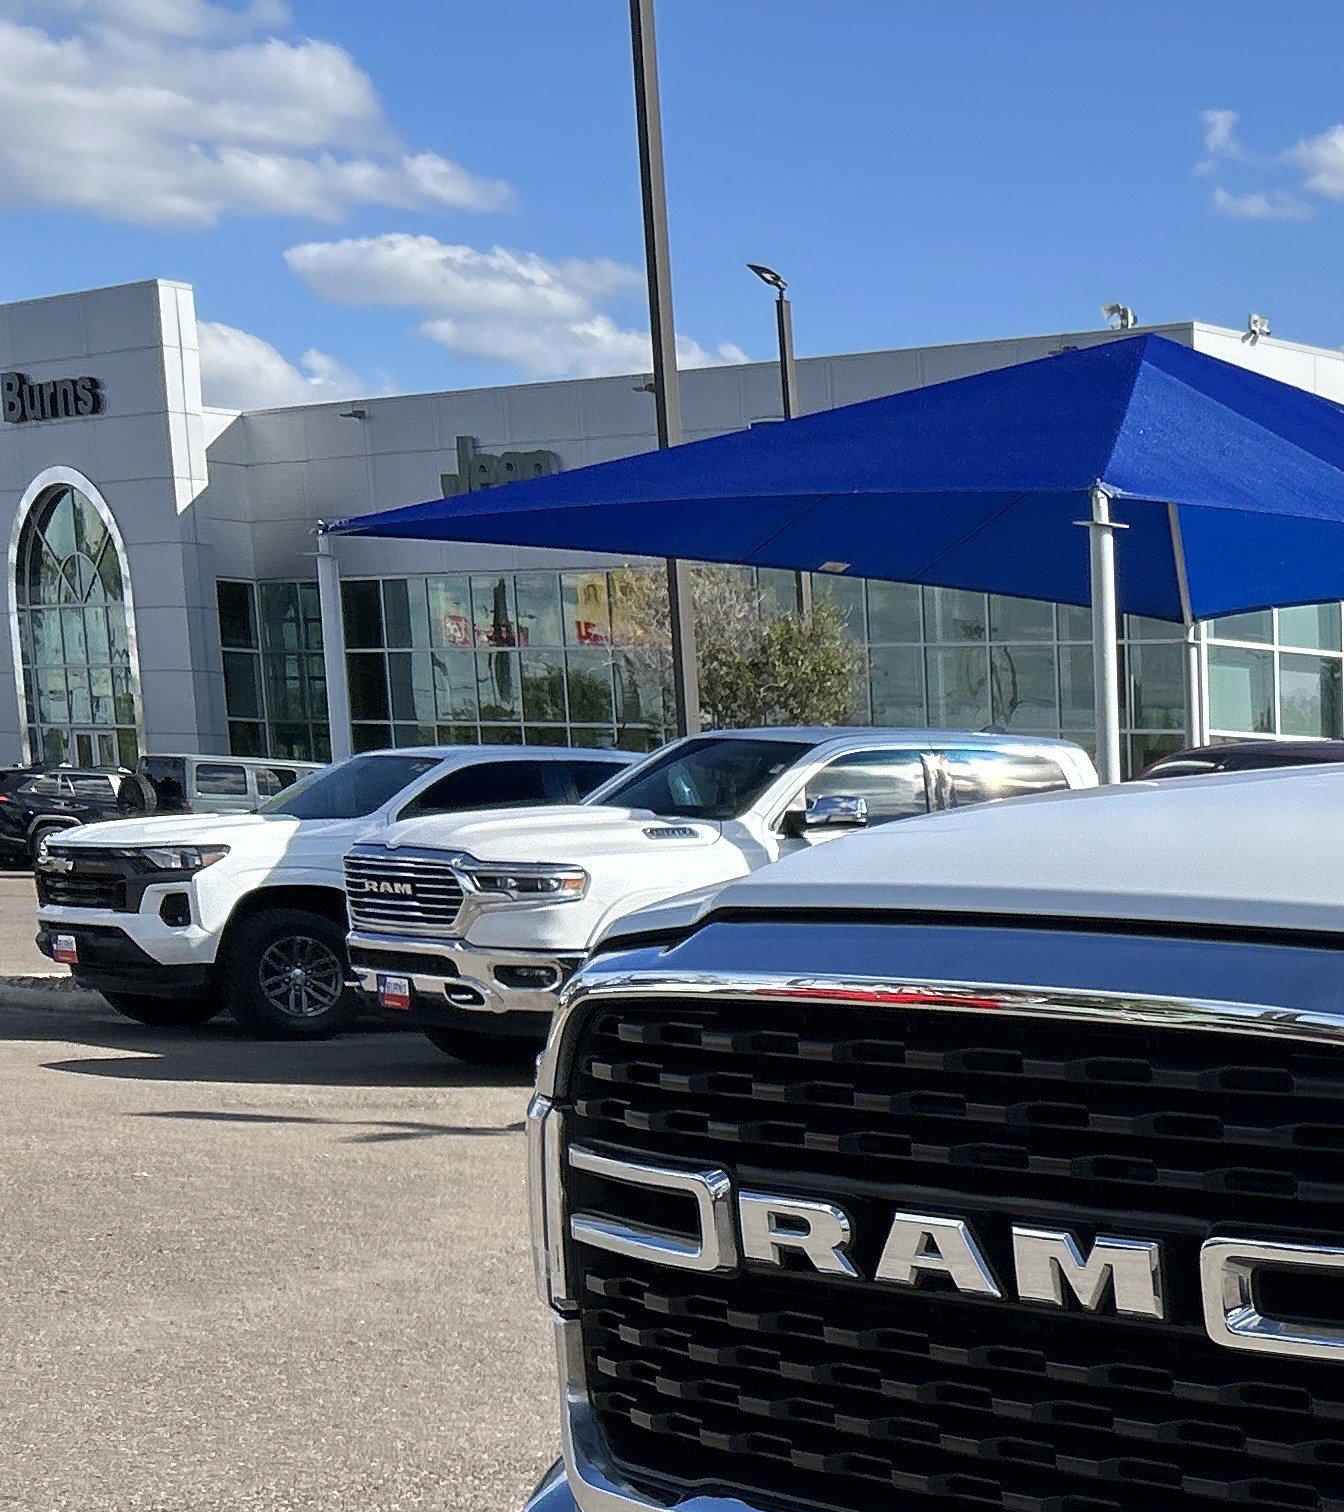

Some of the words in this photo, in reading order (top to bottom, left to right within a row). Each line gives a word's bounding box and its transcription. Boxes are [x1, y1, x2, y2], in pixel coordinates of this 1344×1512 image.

[1, 372, 104, 423] Burns
[365, 880, 413, 895] RAM
[738, 1191, 1167, 1320] RAM
